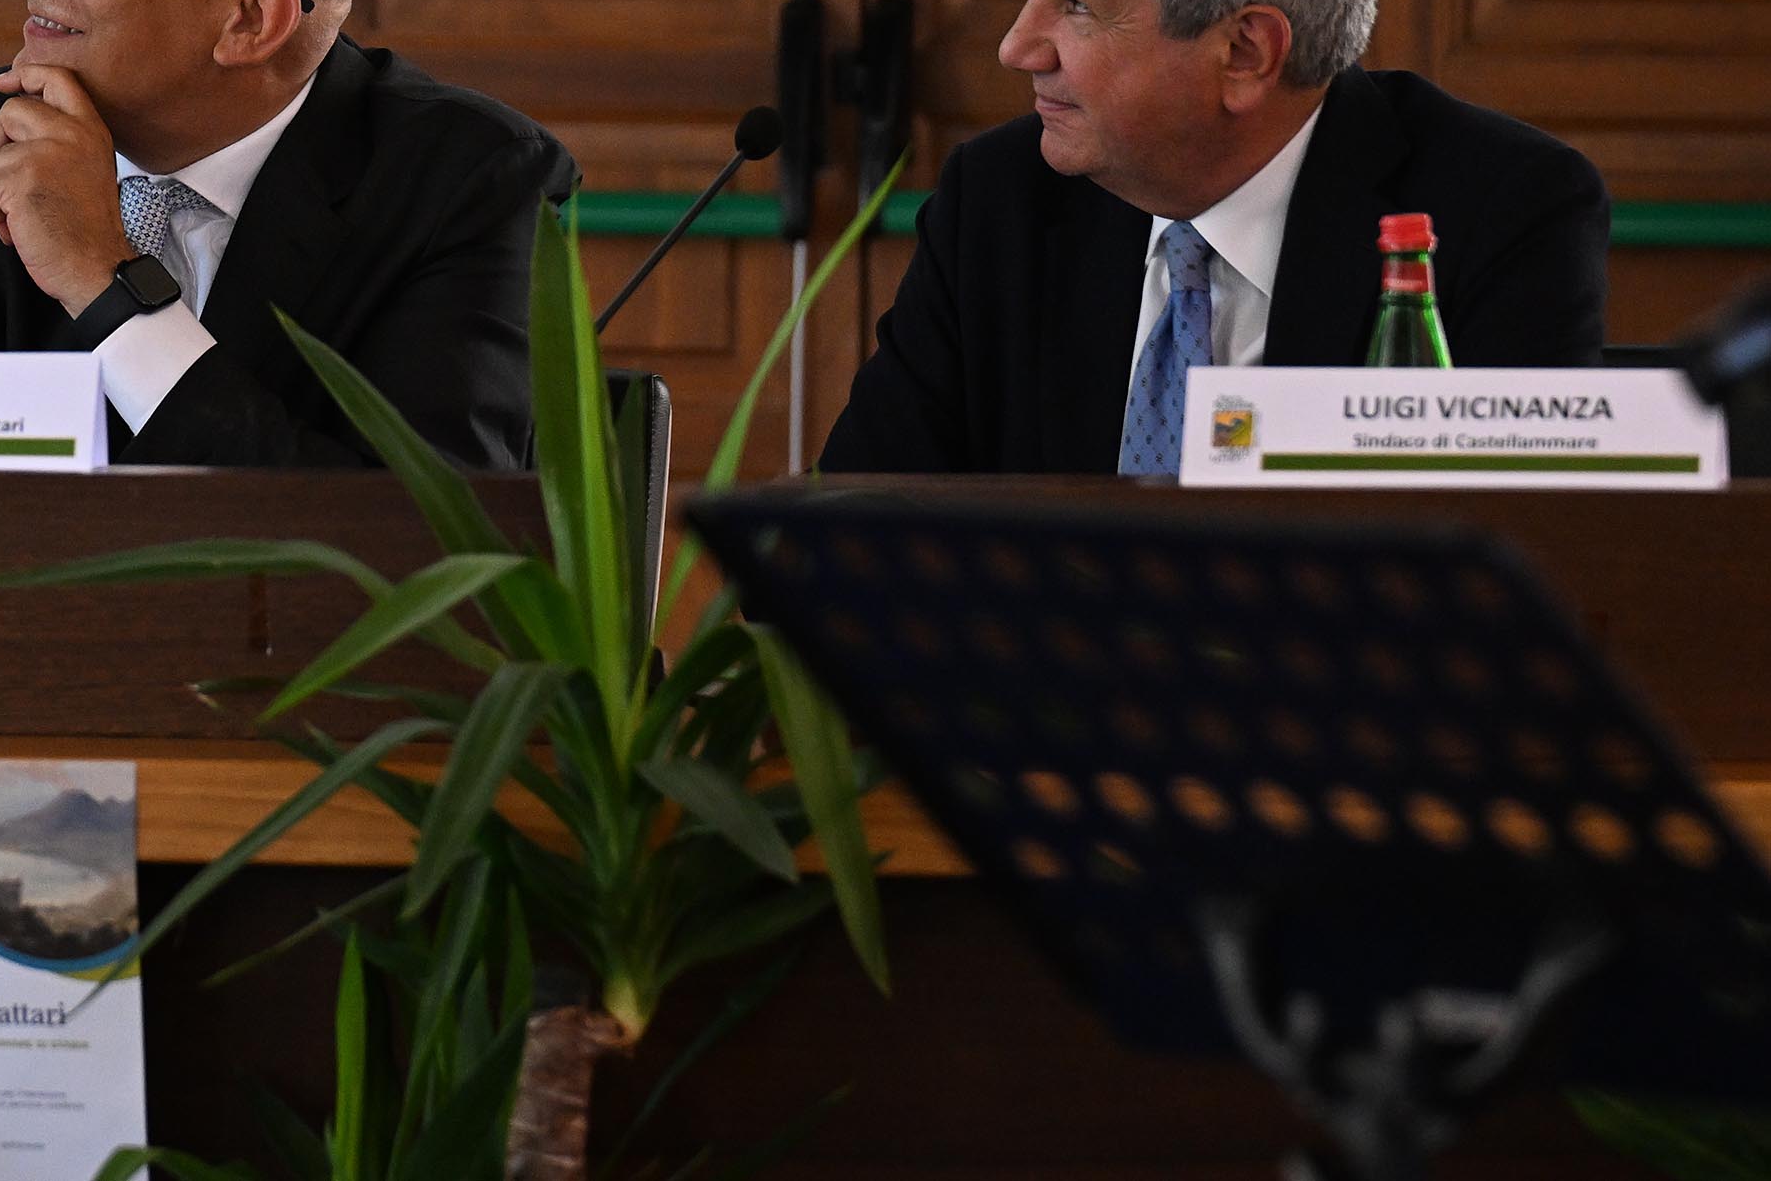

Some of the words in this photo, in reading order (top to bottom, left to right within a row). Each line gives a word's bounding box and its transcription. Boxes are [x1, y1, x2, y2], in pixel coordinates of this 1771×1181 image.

[1342, 395, 1427, 420] LUIGI
[1436, 395, 1614, 420] VICINANZA
[1353, 433, 1426, 450] Sindaco
[1431, 433, 1449, 450] di
[1455, 433, 1597, 450] Castellammare
